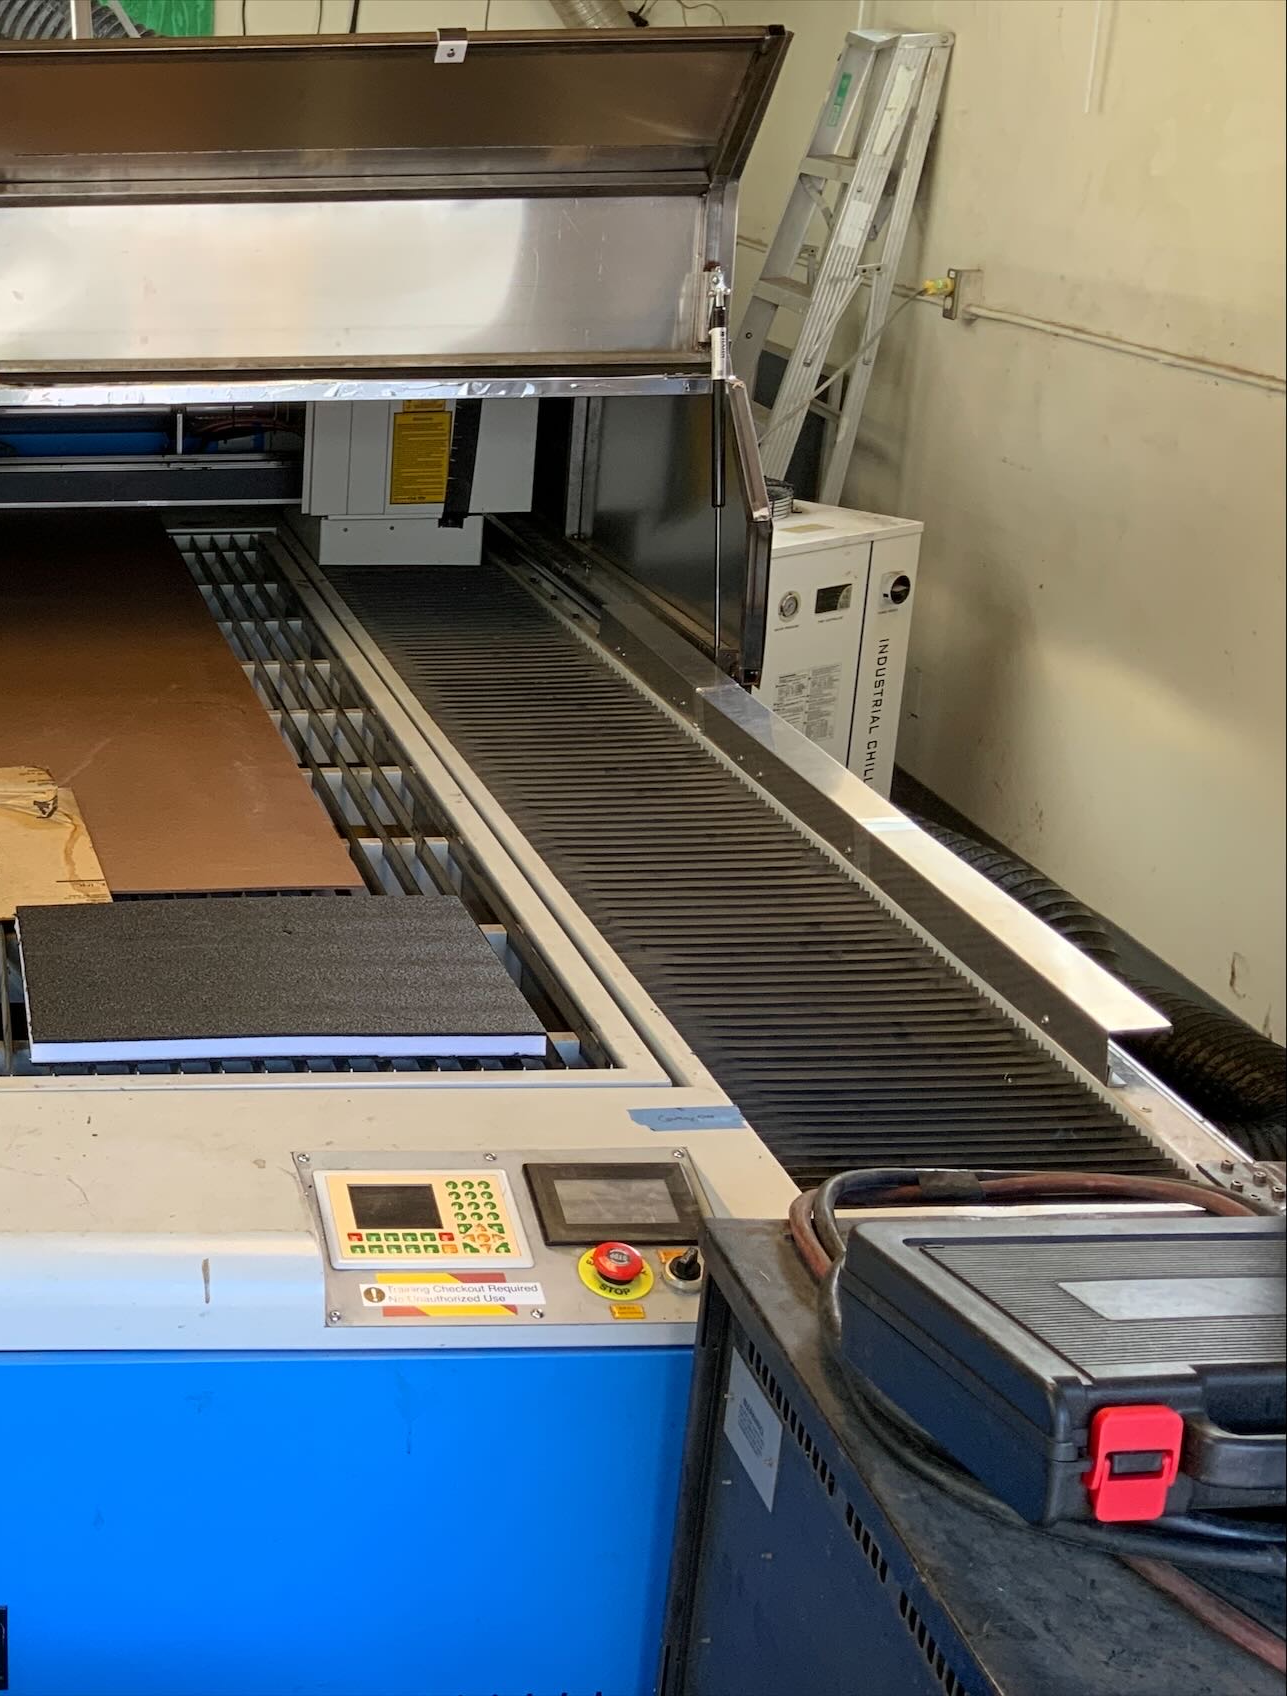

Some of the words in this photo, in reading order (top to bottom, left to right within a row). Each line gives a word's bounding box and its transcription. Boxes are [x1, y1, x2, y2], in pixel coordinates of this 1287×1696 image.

[868, 638, 891, 735] INDUSTRIAL
[386, 1284, 431, 1295] Training
[432, 1284, 486, 1294] Checkout
[487, 1284, 539, 1294] Required
[599, 1283, 631, 1296] STOP
[406, 1294, 481, 1303] Unauthorized
[483, 1294, 507, 1303] Use
